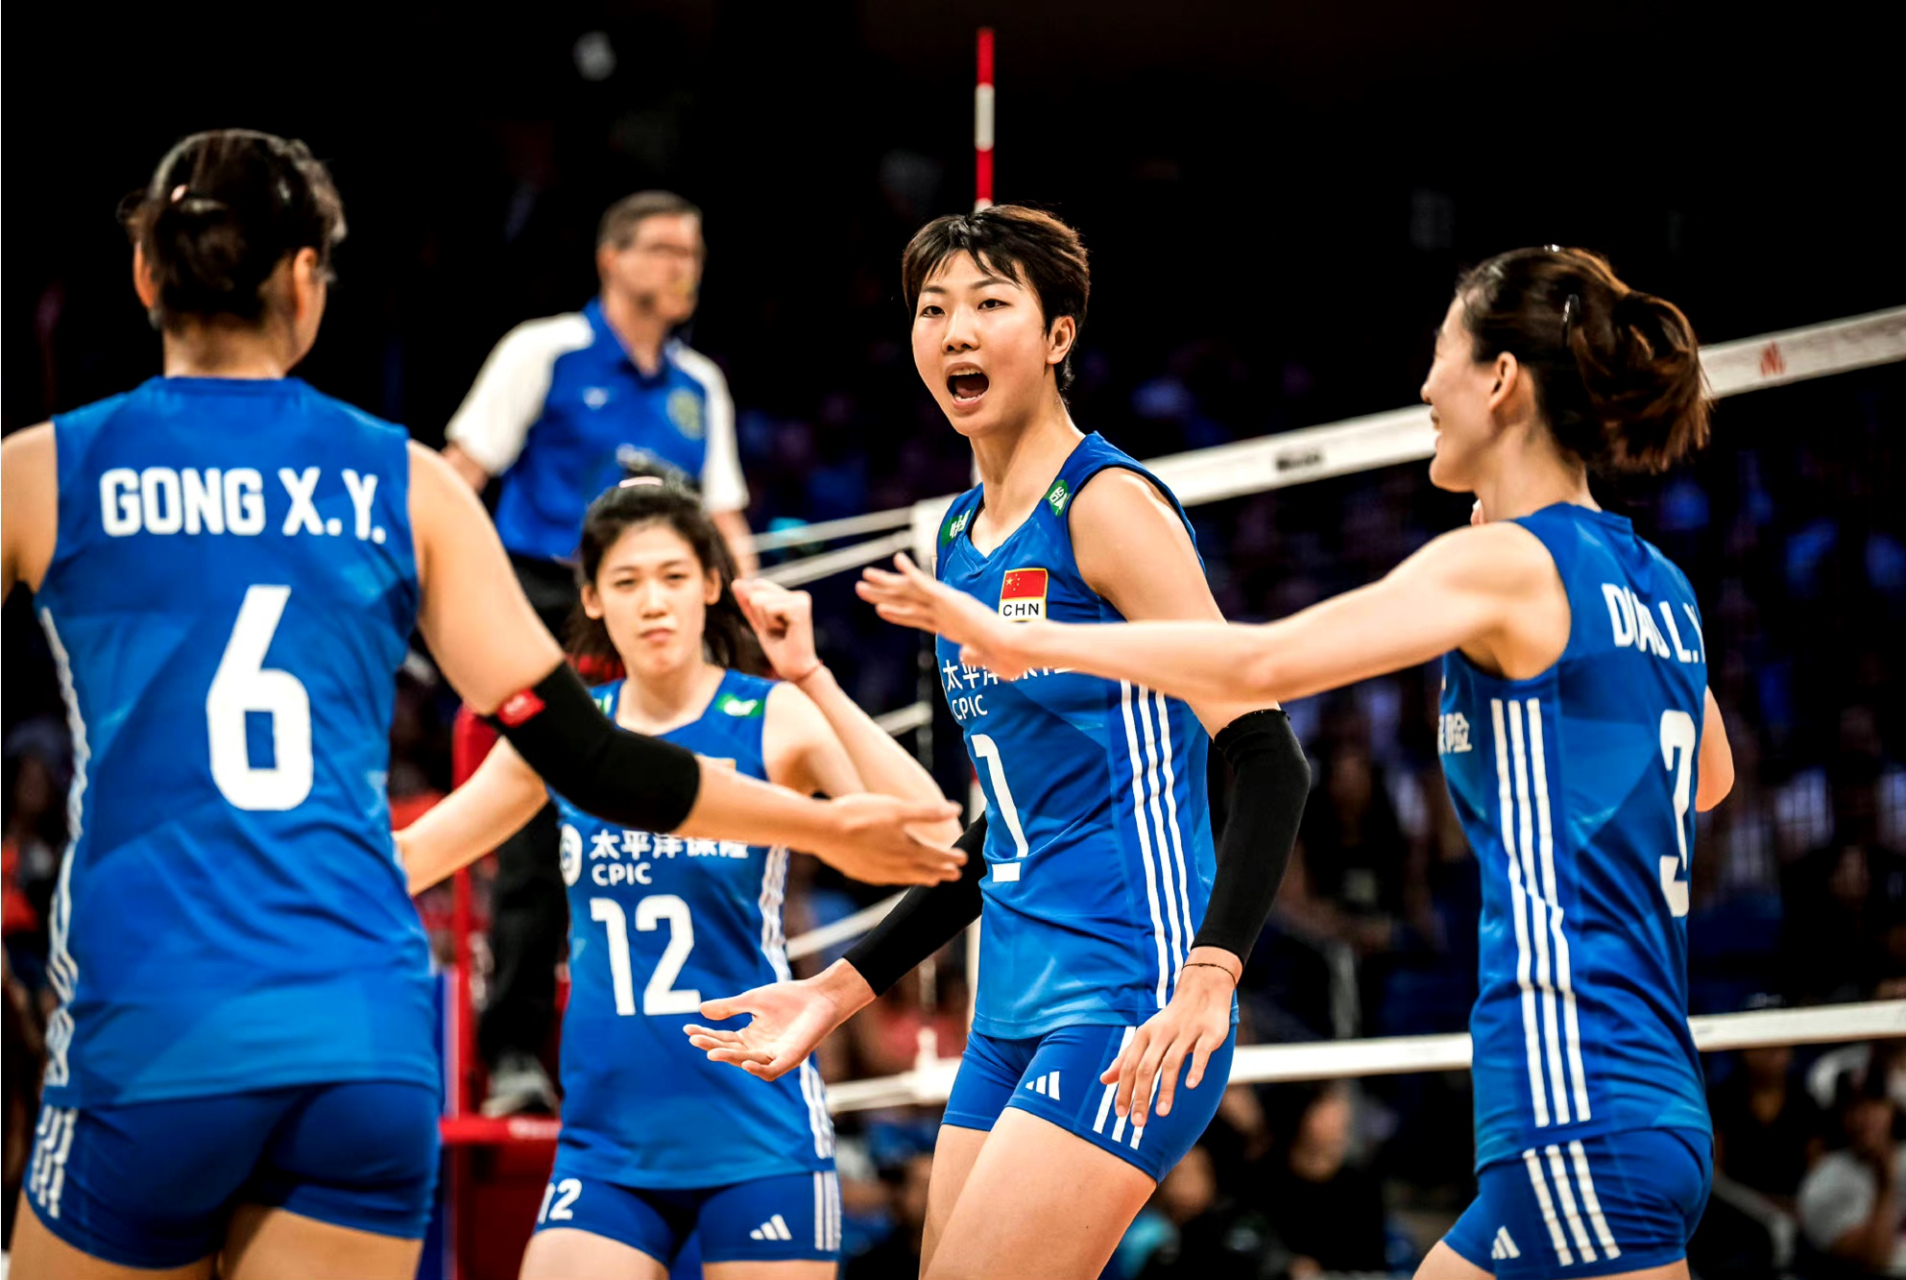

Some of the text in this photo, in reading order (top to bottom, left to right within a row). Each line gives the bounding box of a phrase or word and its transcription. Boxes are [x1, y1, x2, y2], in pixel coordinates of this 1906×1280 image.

[100, 466, 267, 537] GONG
[1002, 602, 1040, 617] CHN
[205, 583, 315, 811] 6
[951, 694, 988, 721] CPIC
[970, 733, 1029, 883] 1
[1659, 709, 1696, 918] 3
[591, 862, 653, 887] CPIC
[589, 894, 702, 1016] 12
